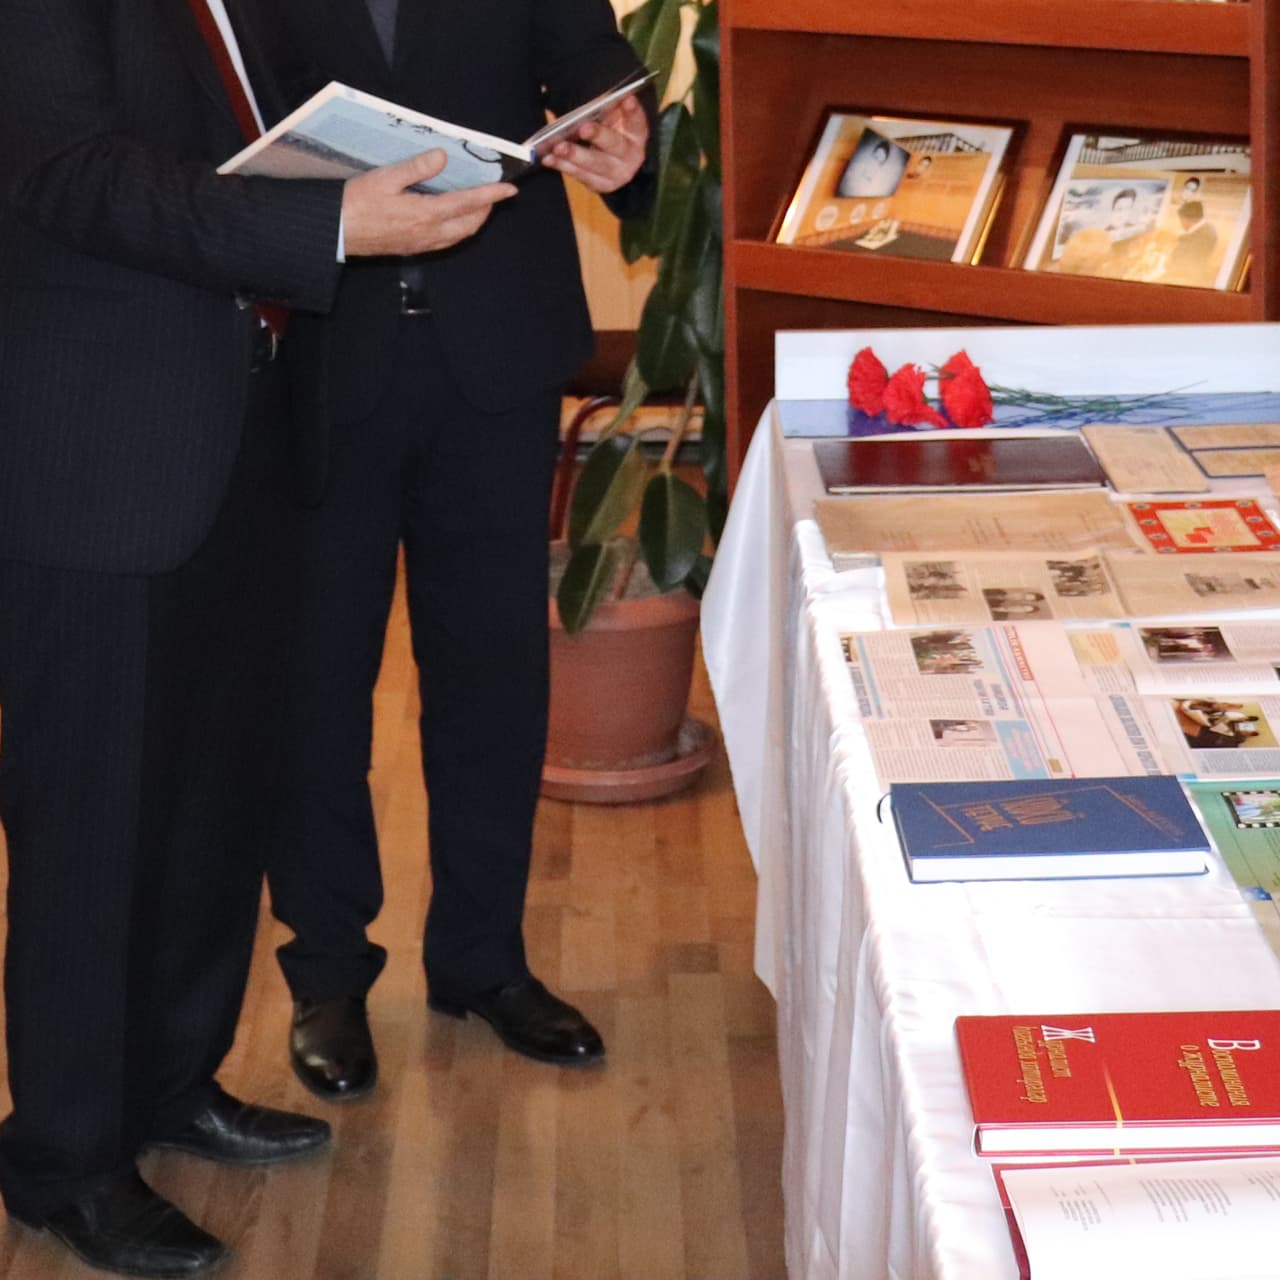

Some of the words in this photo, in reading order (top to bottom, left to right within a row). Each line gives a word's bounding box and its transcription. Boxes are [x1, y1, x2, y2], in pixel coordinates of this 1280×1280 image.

[1037, 1024, 1096, 1078] Журналист
[1177, 1051, 1220, 1107] журналисте
[1207, 1038, 1261, 1106] Воспоминания
